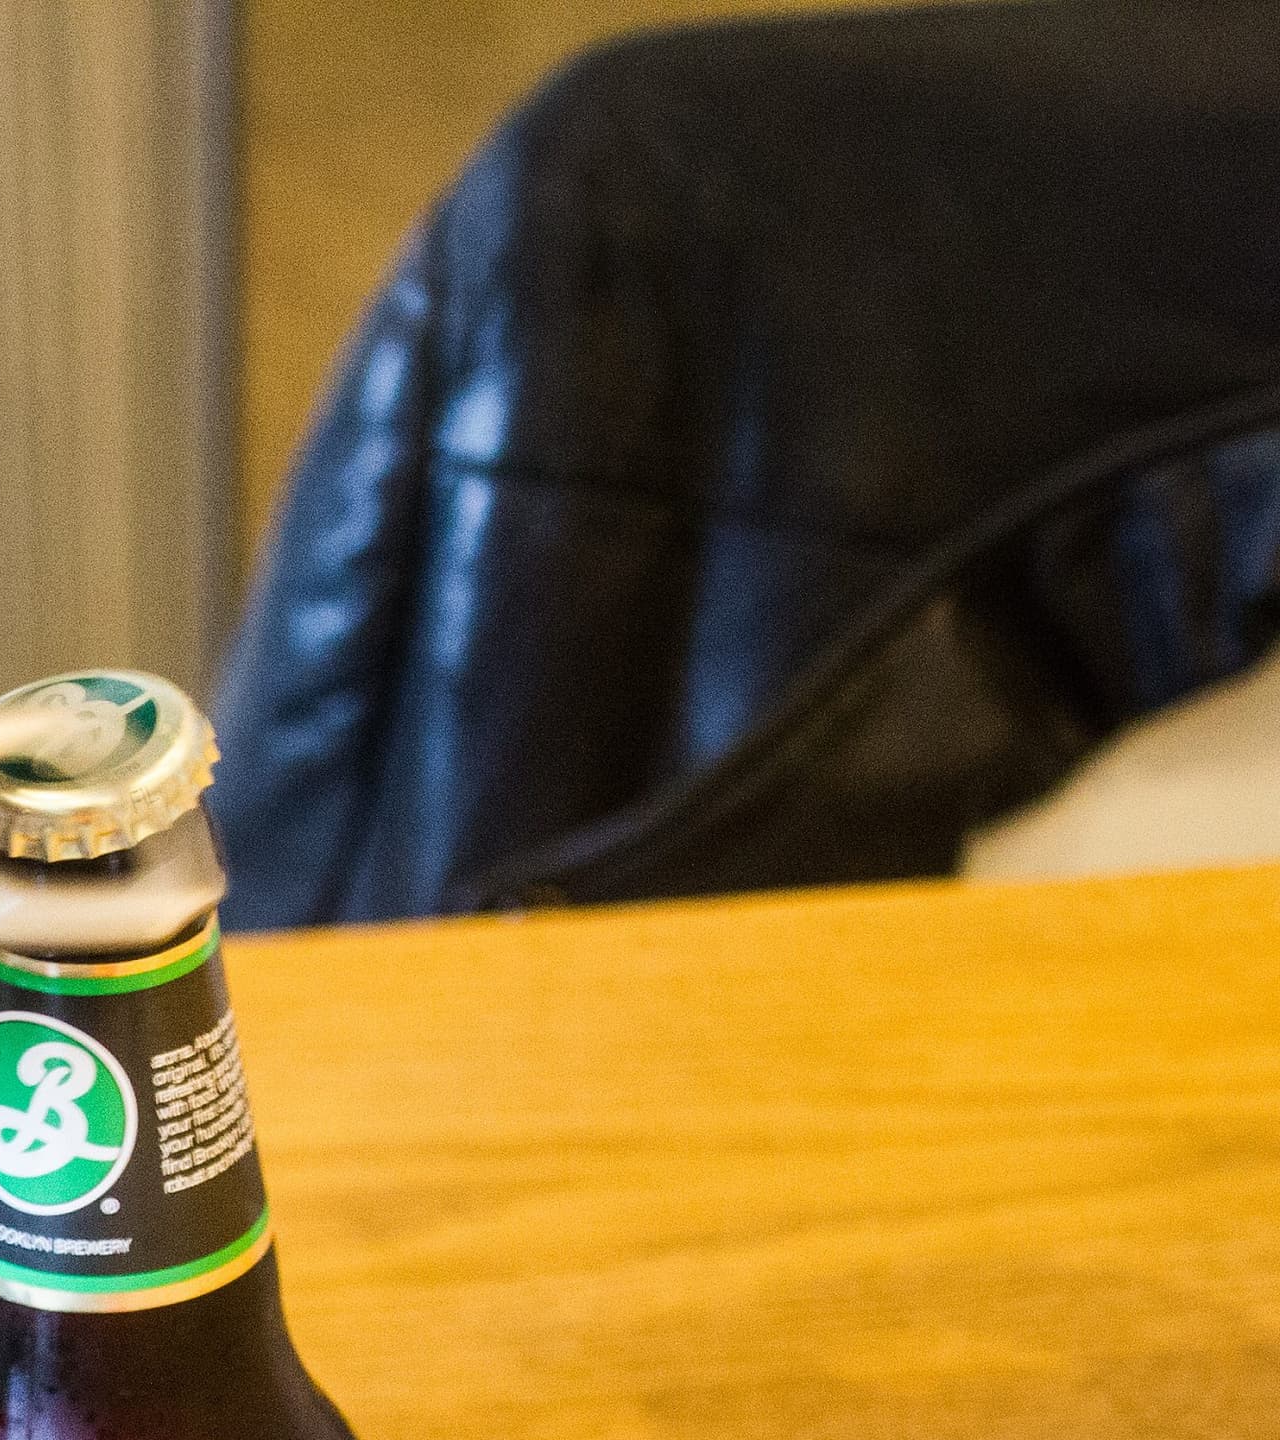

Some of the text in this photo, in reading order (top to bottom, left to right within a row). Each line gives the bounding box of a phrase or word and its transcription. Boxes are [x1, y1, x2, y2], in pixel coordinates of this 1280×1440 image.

[157, 1117, 193, 1142] your
[160, 1134, 195, 1160] your
[53, 1238, 132, 1256] BREWERY
